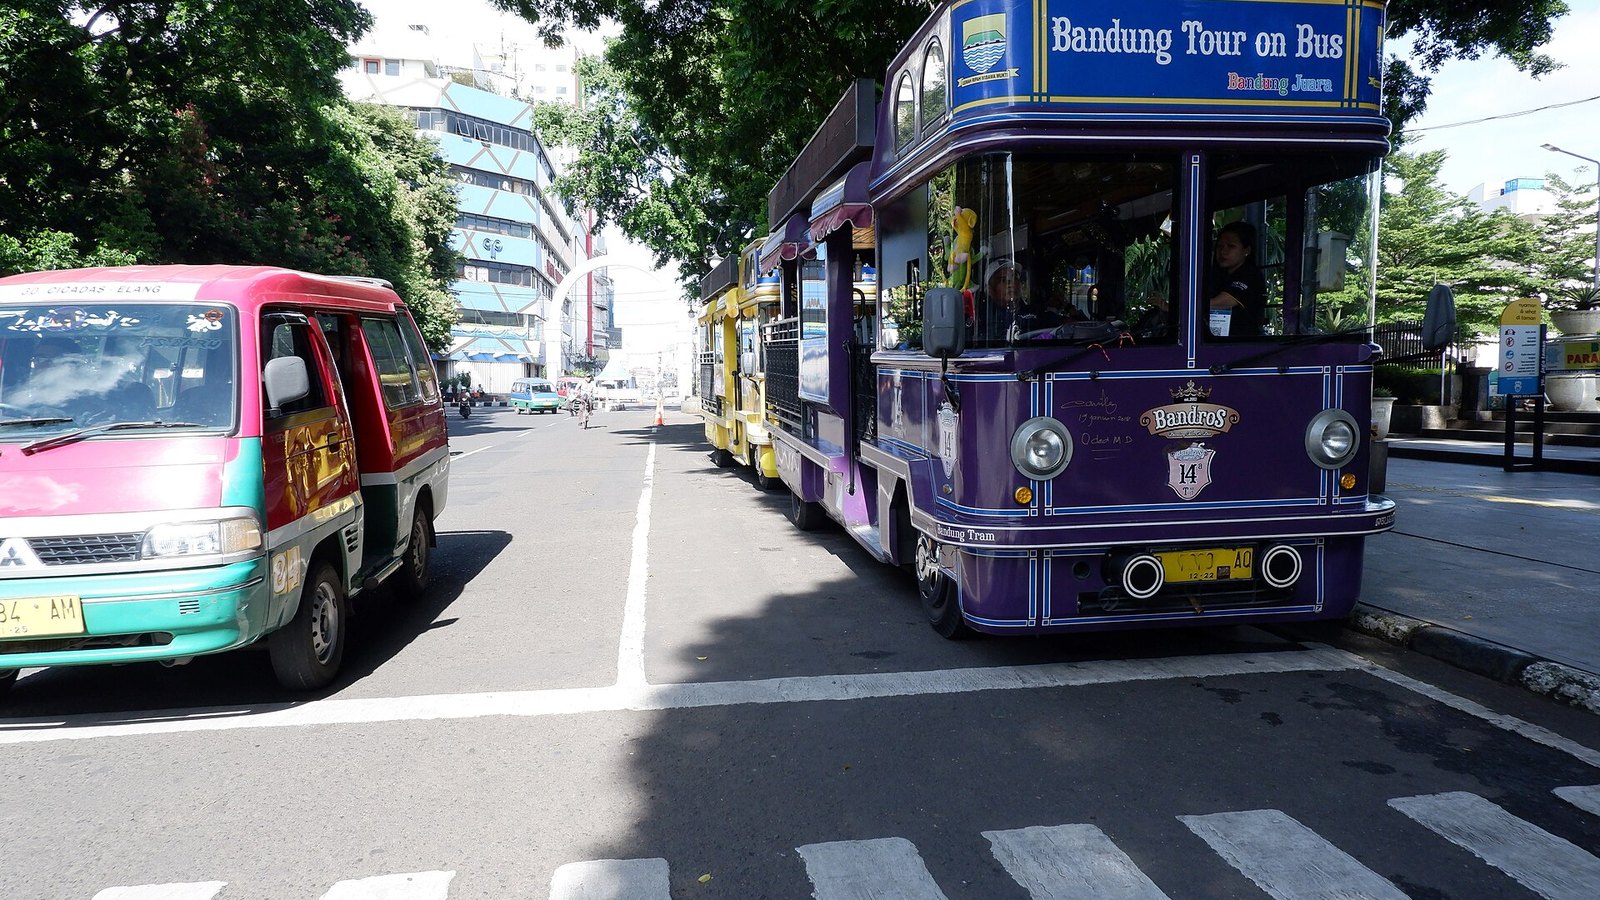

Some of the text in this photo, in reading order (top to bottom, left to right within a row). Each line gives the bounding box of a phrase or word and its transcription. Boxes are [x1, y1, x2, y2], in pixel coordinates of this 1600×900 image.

[1051, 16, 1344, 65] Bandung Tour on Bus
[1227, 71, 1333, 96] Bandung Juara
[47, 285, 105, 294] CICADAS
[117, 285, 162, 294] ELANG
[1153, 405, 1227, 430] Bandros
[1179, 463, 1197, 484] 14
[937, 523, 995, 543] Bandung Tram
[51, 598, 76, 620] AM
